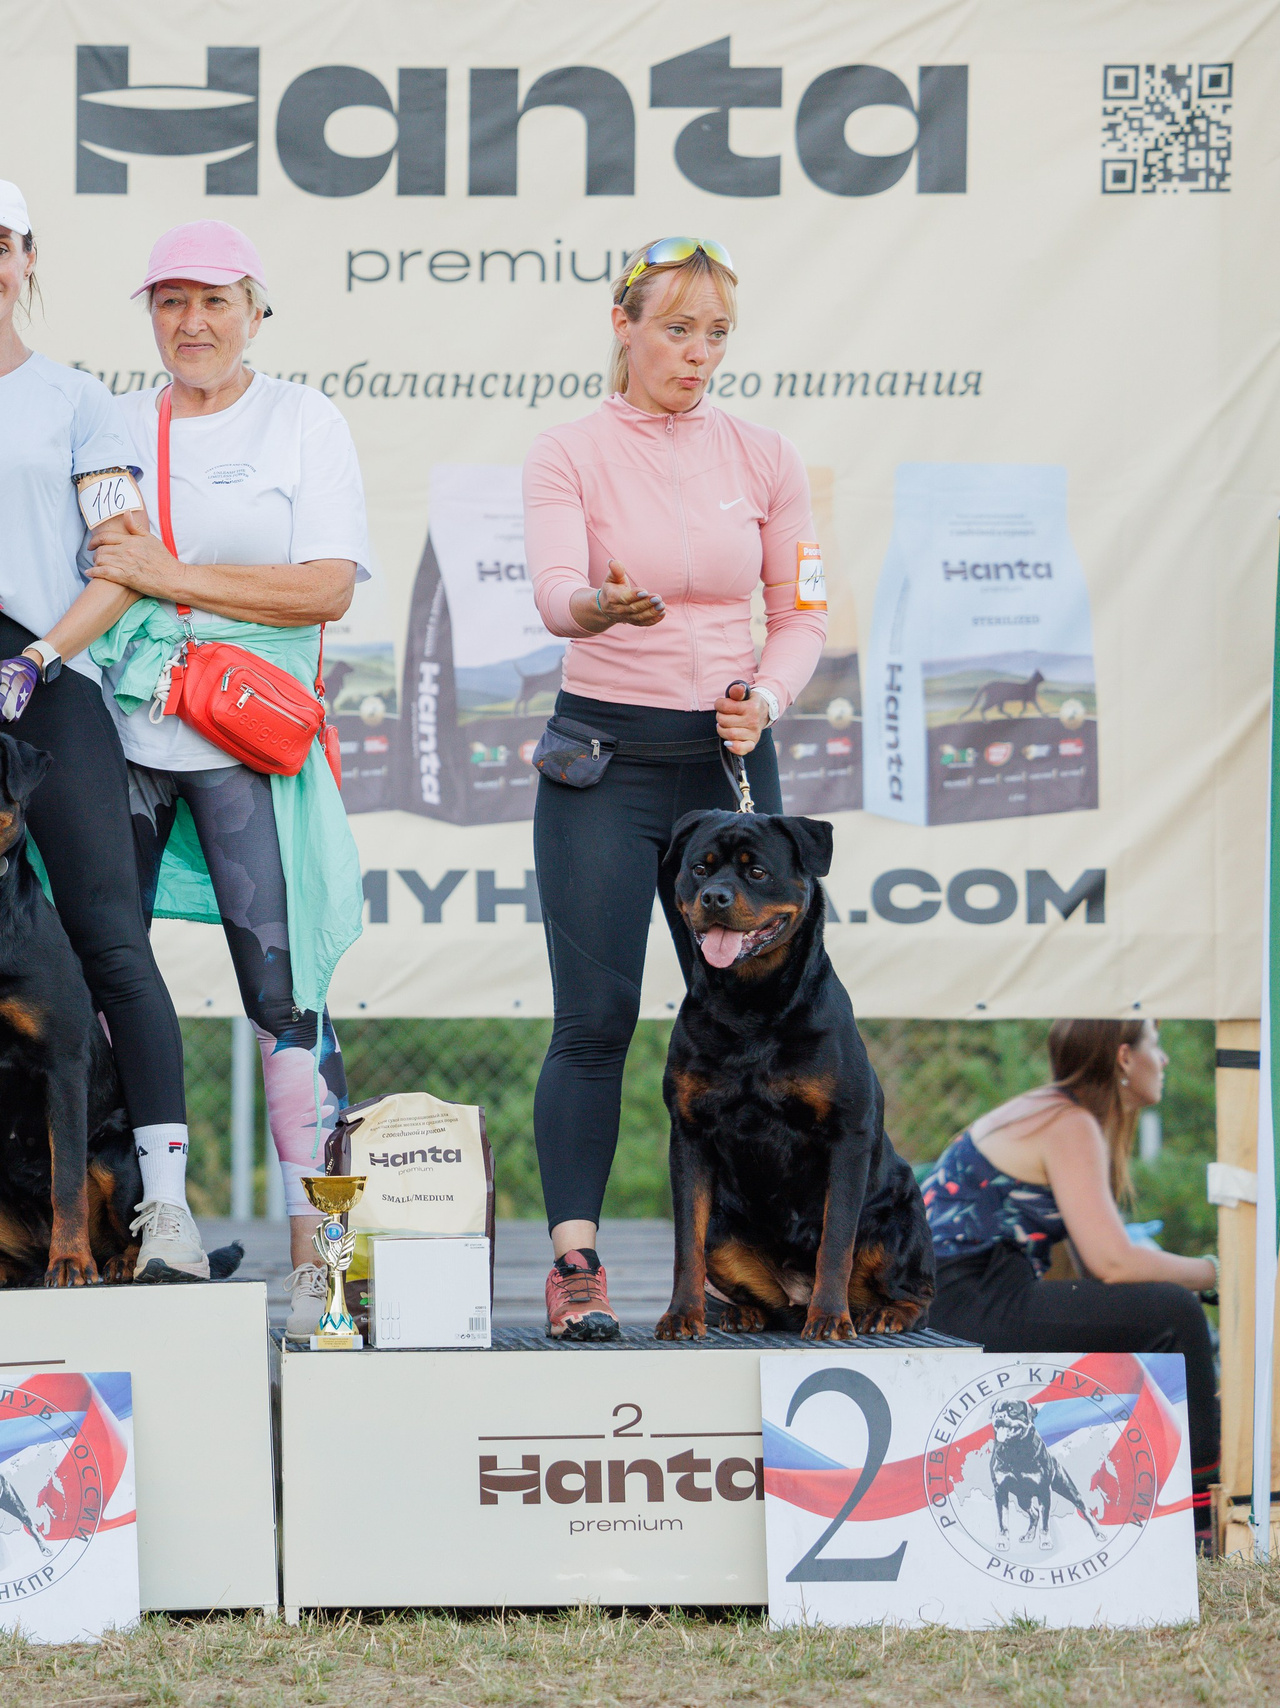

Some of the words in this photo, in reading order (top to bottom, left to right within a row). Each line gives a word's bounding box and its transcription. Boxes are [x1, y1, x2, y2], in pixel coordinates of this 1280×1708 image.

[74, 35, 968, 197] Hanta
[321, 359, 762, 409] сбалансировго
[773, 369, 984, 399] питания
[91, 477, 125, 520] 116
[942, 559, 1054, 581] Hanta
[419, 661, 441, 805] Hanta
[885, 662, 905, 803] Hanta
[369, 1145, 462, 1168] Hanta
[398, 1166, 434, 1176] premium
[381, 1193, 455, 1204] SMALL/MEDIUM
[612, 1403, 643, 1437] 2
[928, 1371, 1011, 1529] РОТВЕЙЛЕР
[1029, 1367, 1106, 1403] КЛУБ
[1113, 1407, 1153, 1529] РОССИИ
[61, 1425, 99, 1544] РОССИИ
[479, 1447, 765, 1505] Hanta
[786, 1367, 908, 1582] 2
[570, 1514, 683, 1535] premium
[986, 1551, 1110, 1585] РКФ-НКПР
